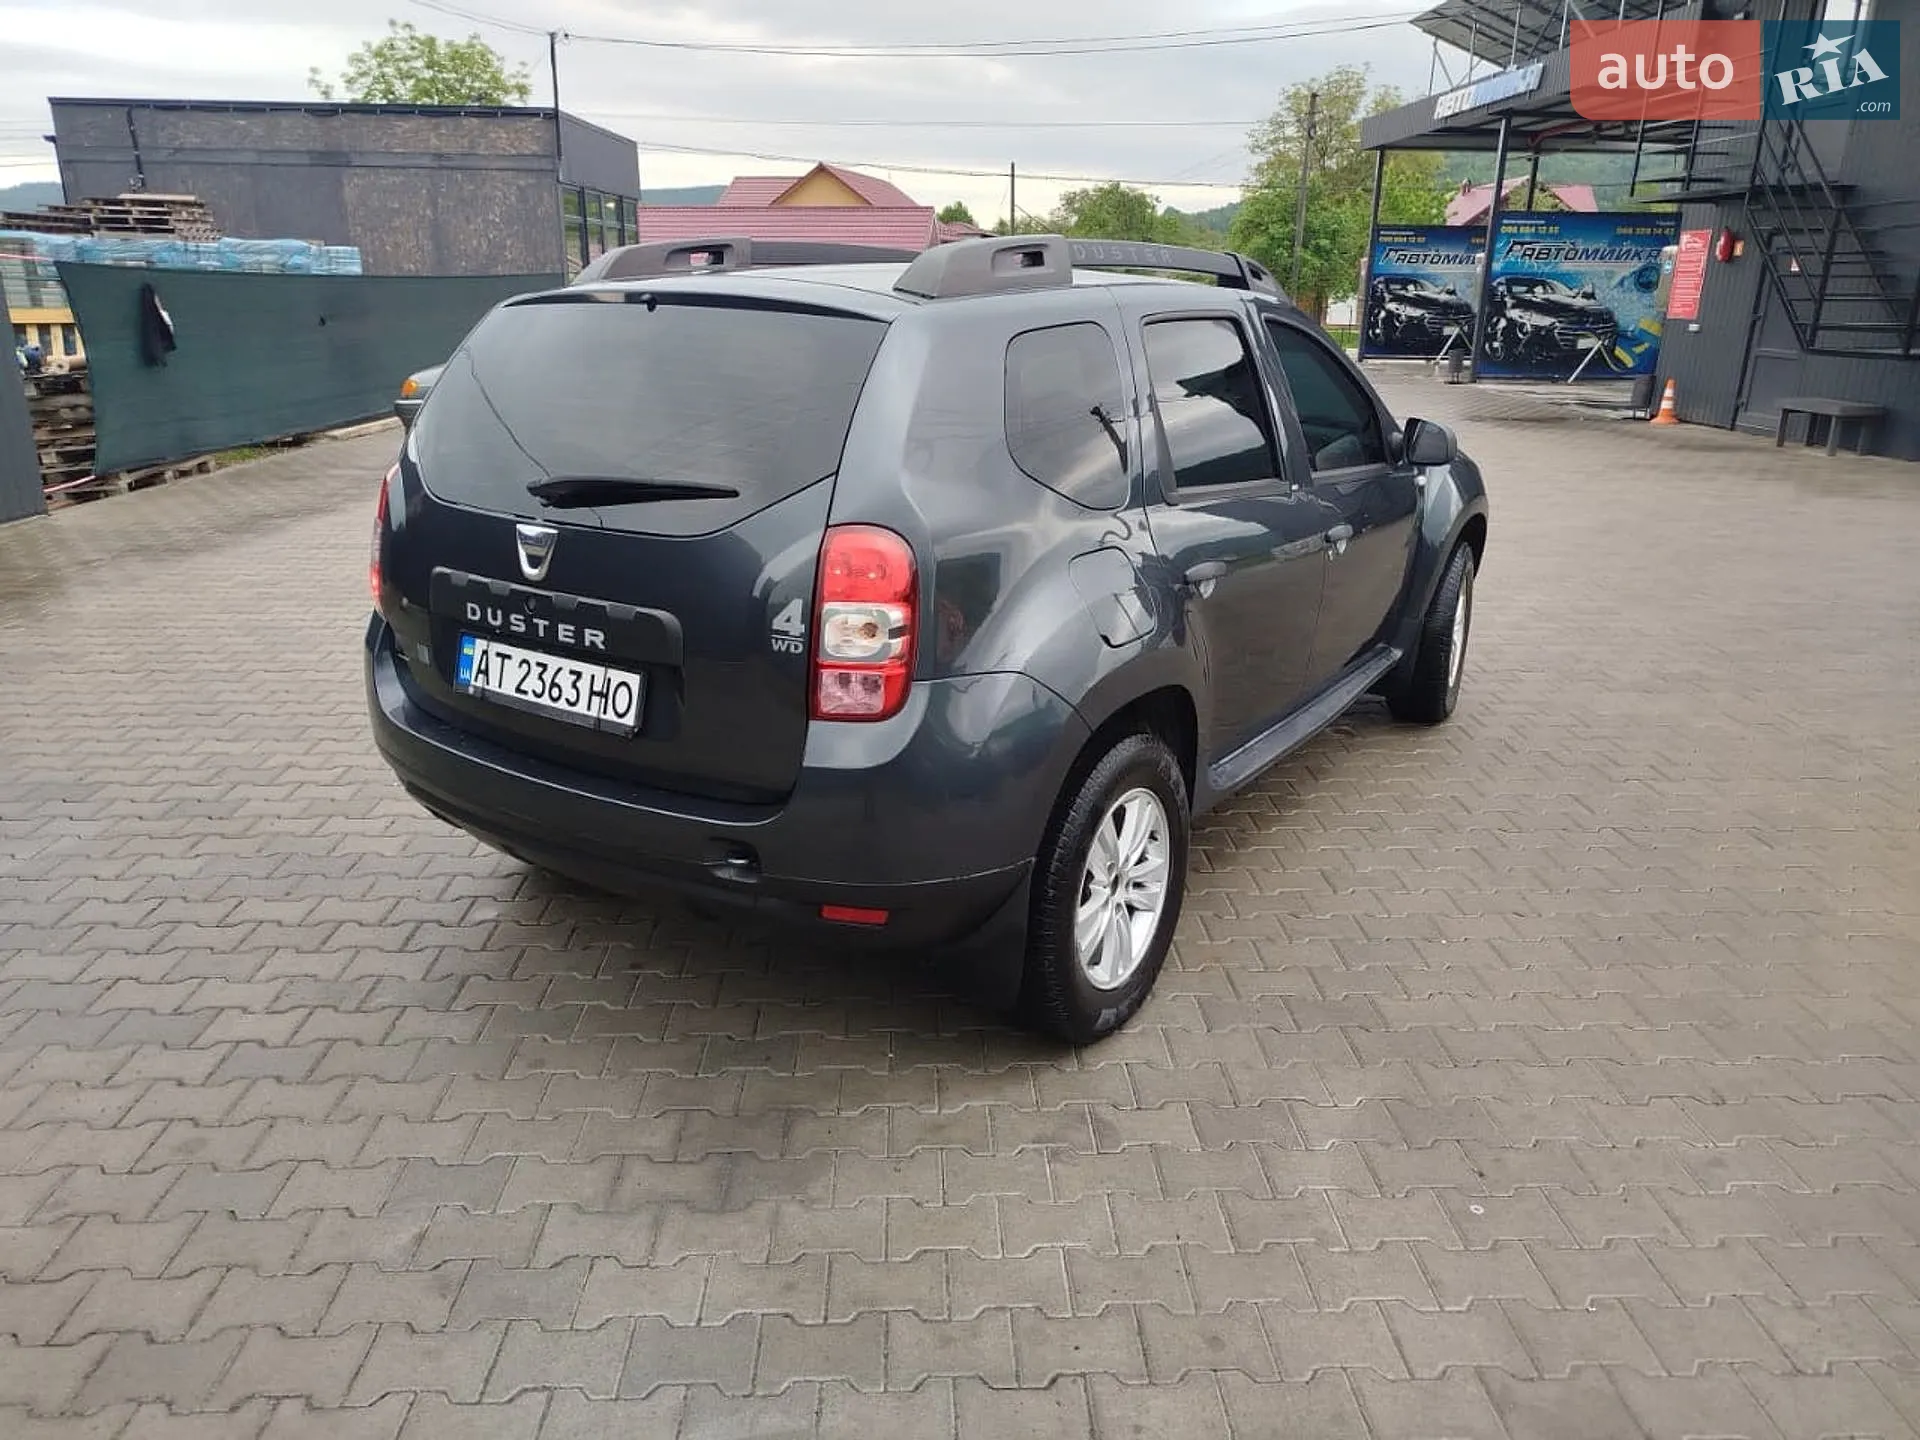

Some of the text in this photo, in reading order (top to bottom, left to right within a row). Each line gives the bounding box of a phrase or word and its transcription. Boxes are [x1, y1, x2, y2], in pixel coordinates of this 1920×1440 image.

[1073, 244, 1174, 264] DUSTER
[466, 602, 607, 650] DUSTER
[771, 638, 804, 654] WD
[515, 658, 583, 708] 2363
